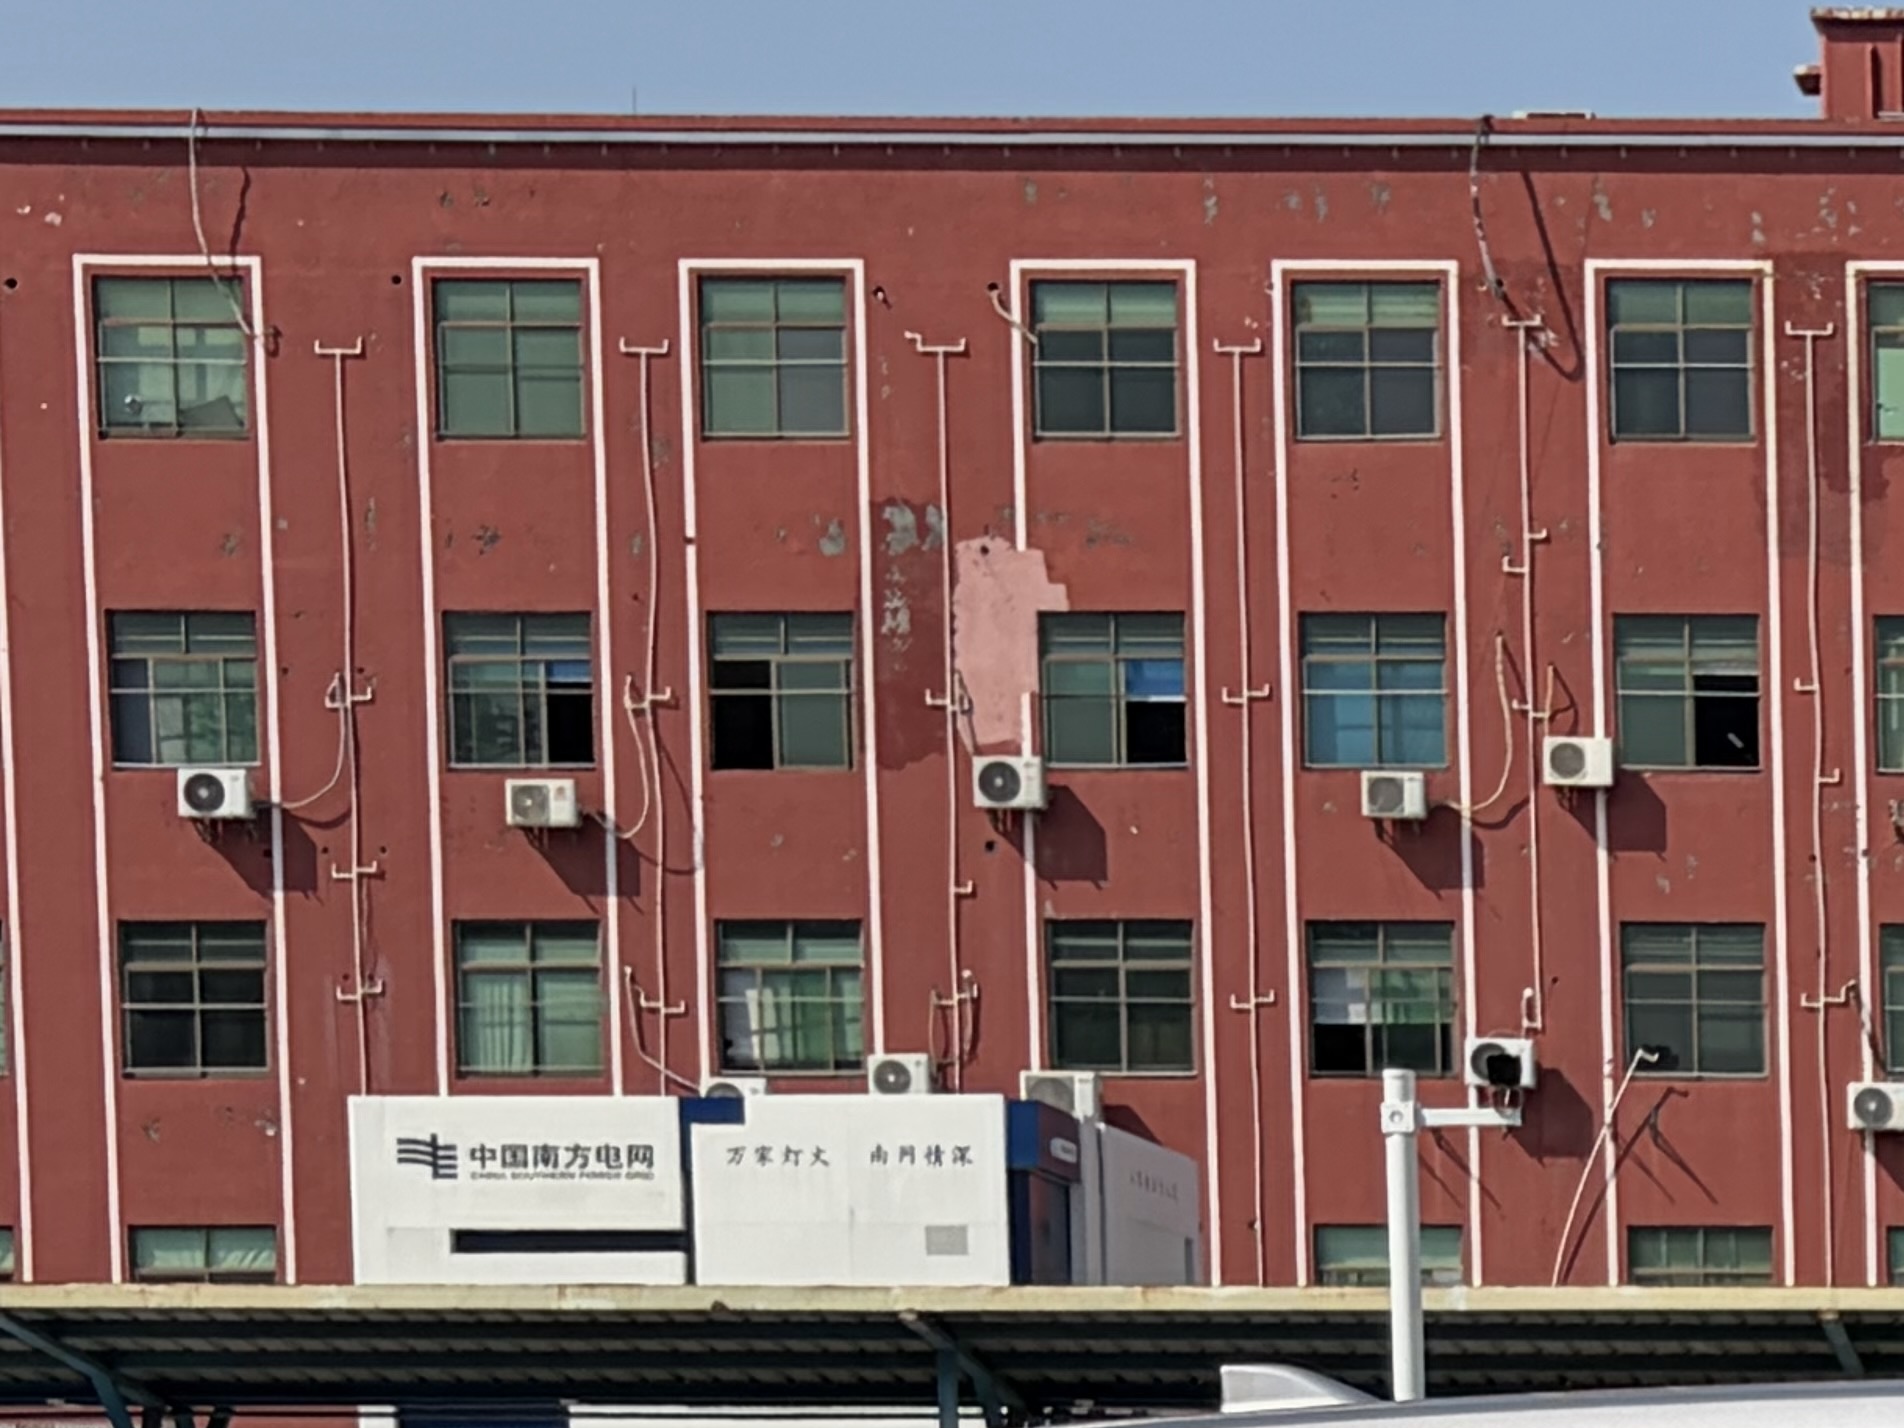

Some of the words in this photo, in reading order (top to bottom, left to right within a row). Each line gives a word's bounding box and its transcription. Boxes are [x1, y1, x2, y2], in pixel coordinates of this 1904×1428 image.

[469, 1143, 655, 1169] 中国南方电网
